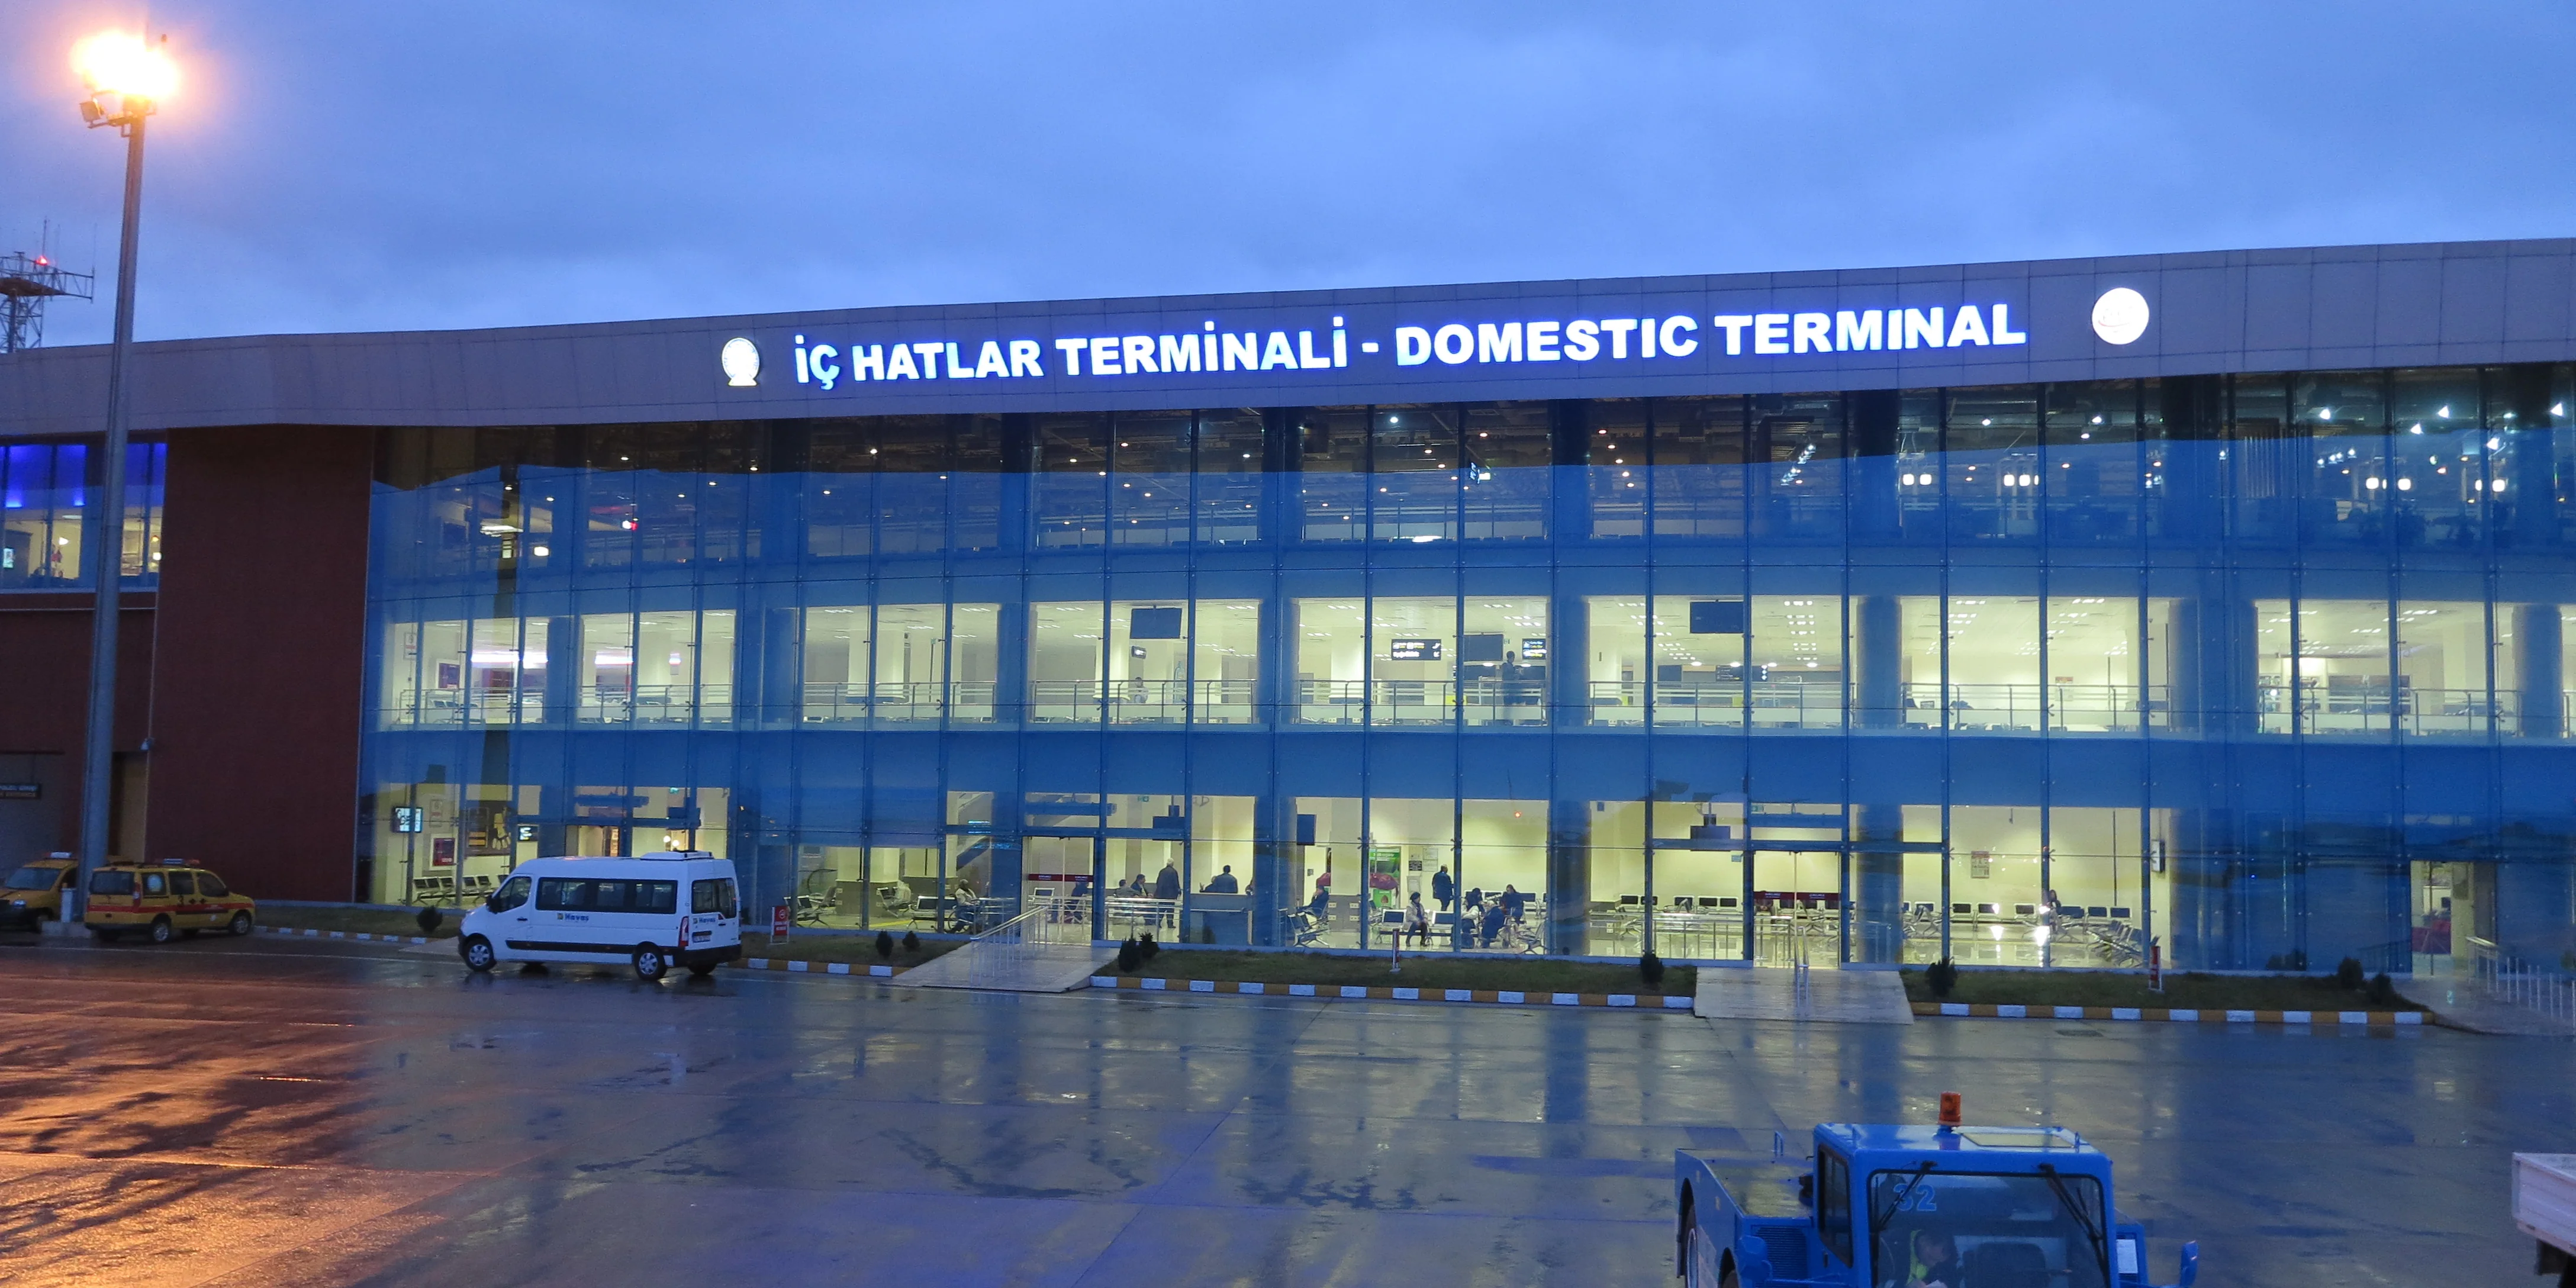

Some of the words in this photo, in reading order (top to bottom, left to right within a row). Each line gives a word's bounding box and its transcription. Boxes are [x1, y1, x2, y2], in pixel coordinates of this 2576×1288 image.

[794, 334, 841, 391] İÇ
[851, 340, 1044, 382] HATLAR
[1055, 315, 1348, 376] TERMİNALİ
[1395, 314, 1699, 366] DOMESTIC
[1713, 303, 2027, 356] TERMINAL
[1893, 1183, 1937, 1212] 32
